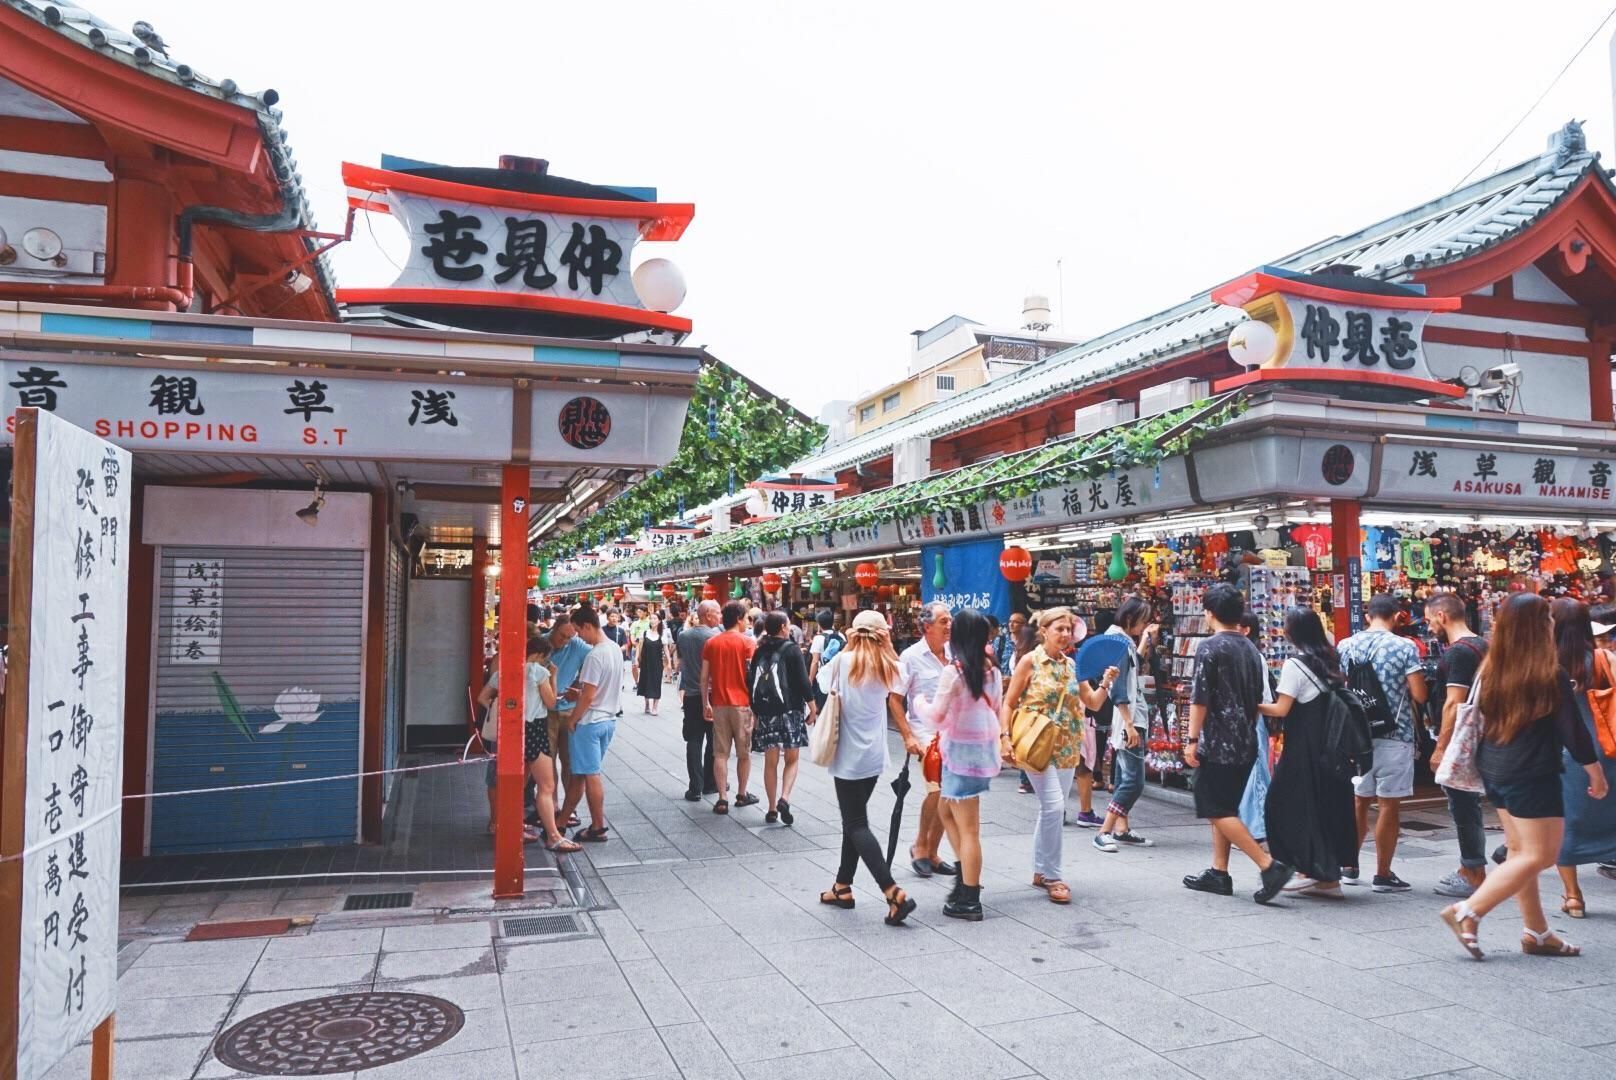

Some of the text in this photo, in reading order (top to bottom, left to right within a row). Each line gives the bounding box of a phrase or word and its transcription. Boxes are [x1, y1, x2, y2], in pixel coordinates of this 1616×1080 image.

[95, 419, 347, 445] SHOPPING S.T
[1062, 474, 1136, 517] 福光屋
[1453, 480, 1611, 500] ASAKUSA NAKAMISE
